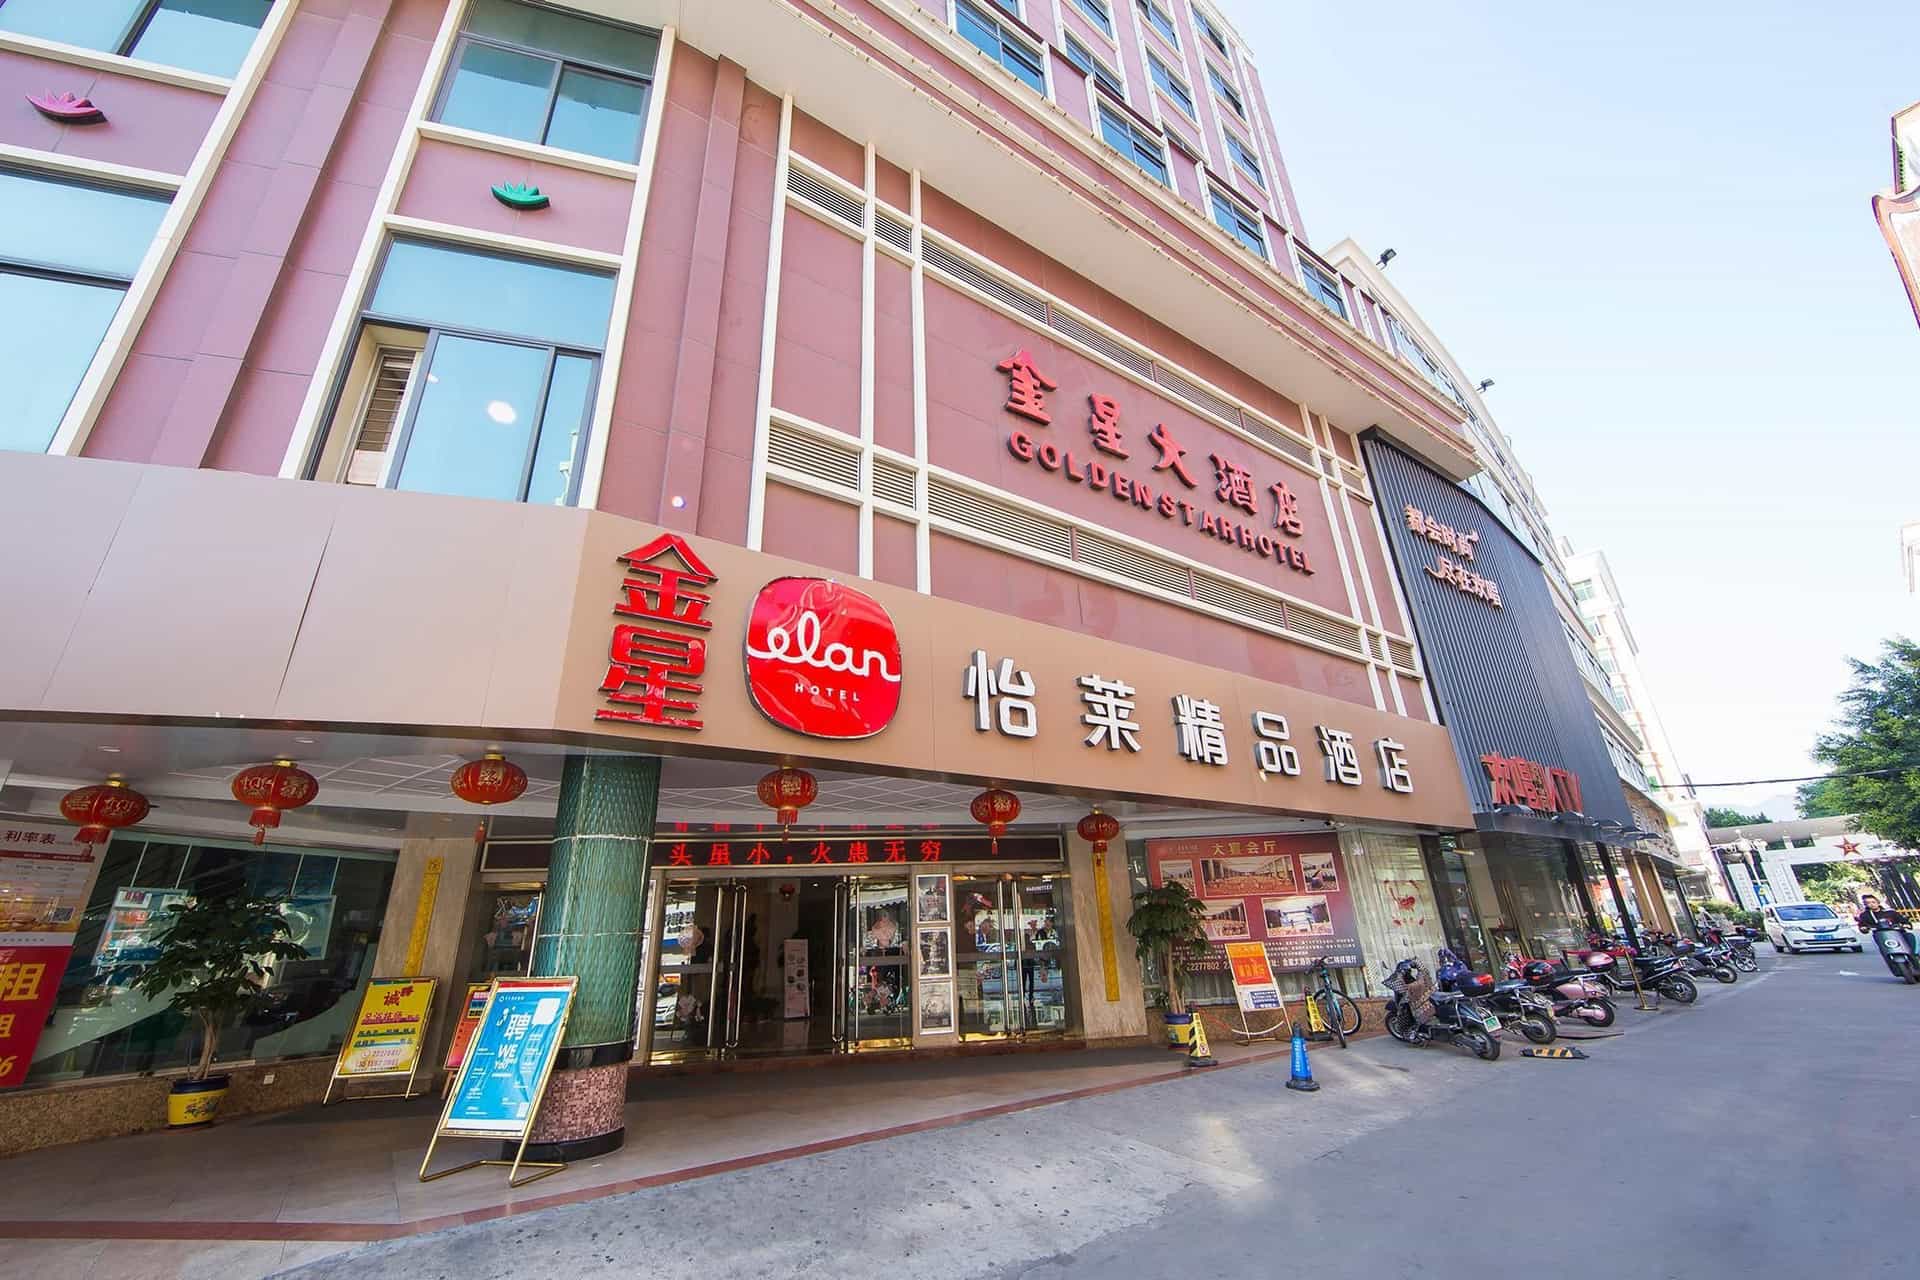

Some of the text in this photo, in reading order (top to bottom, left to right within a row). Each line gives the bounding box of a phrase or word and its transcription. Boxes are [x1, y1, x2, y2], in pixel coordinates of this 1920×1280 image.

[995, 347, 1304, 537] 金星大酒店
[593, 532, 719, 731] 金星
[747, 610, 901, 683] elan
[794, 682, 861, 702] HOTEL
[963, 648, 1416, 794] 怡莱精品酒店
[0, 829, 57, 845] 利率表
